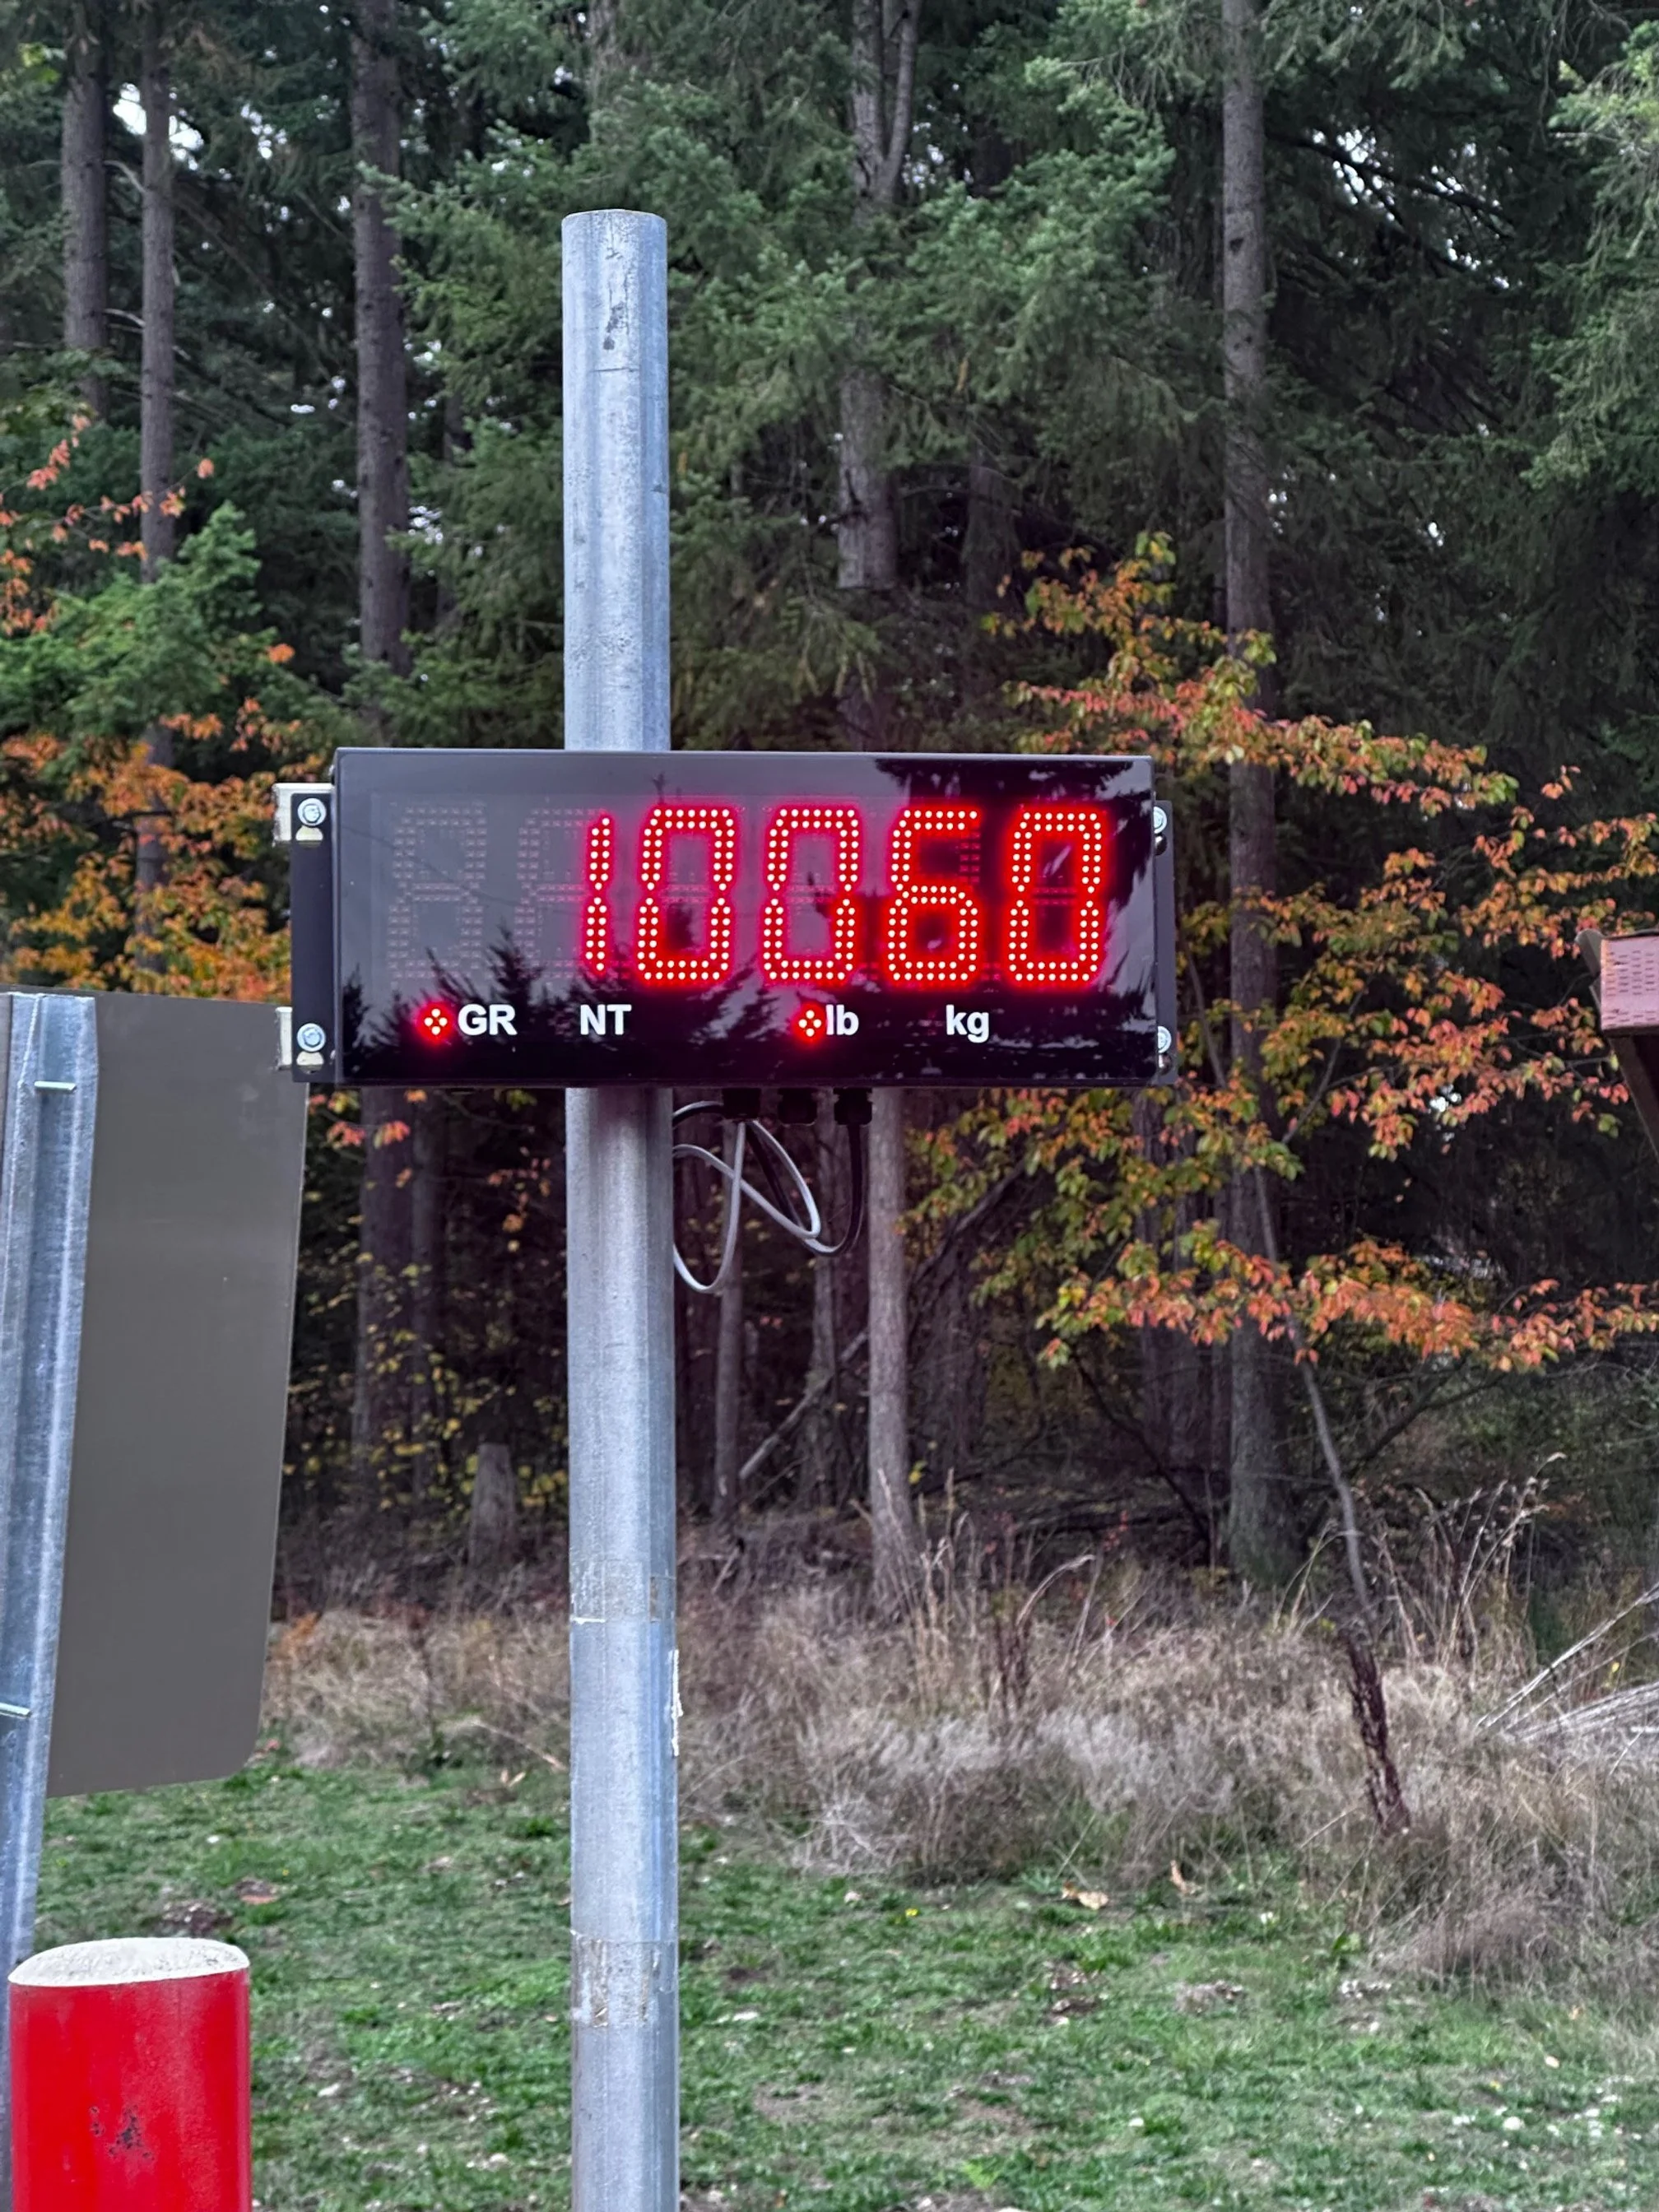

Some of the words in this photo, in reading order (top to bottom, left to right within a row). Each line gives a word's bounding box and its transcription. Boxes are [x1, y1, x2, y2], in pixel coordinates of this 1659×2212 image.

[583, 806, 1104, 984] 10060
[458, 1004, 518, 1036] GR
[579, 1004, 632, 1035] NT
[825, 1004, 859, 1036] lb
[946, 1004, 989, 1043] kg
